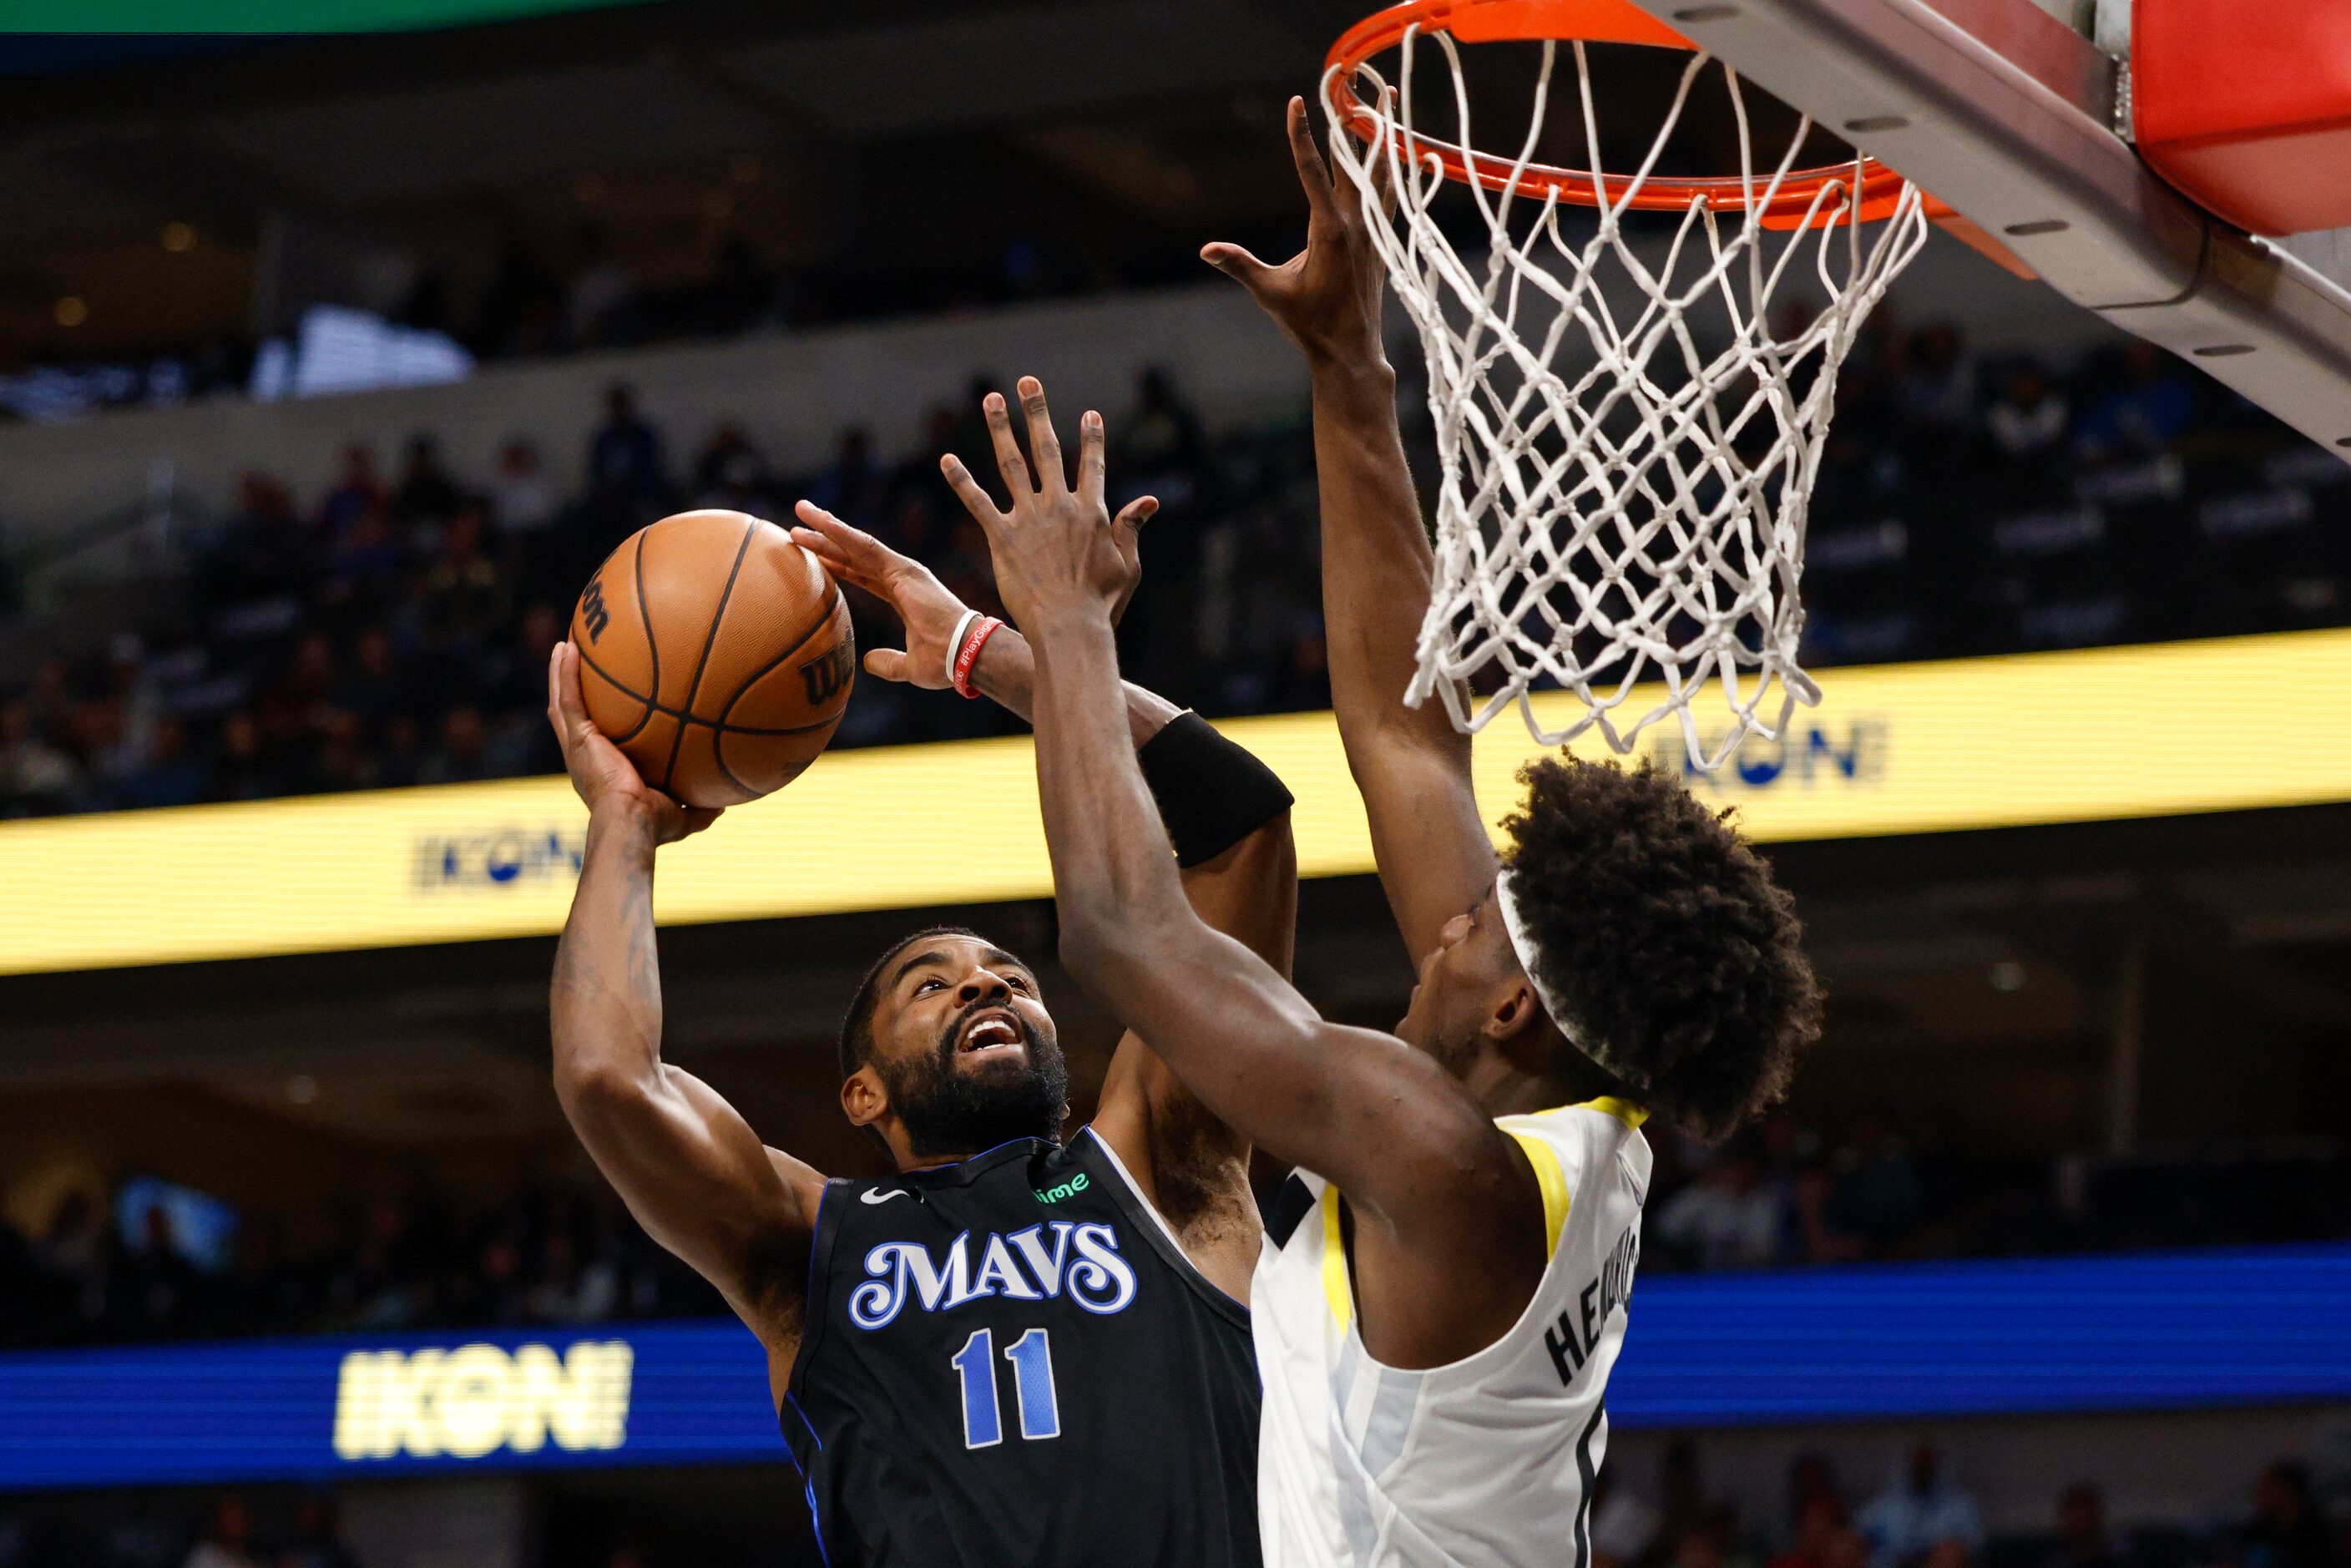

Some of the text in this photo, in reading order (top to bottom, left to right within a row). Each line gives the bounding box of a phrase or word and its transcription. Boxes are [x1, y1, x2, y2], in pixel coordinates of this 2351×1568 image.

[1031, 1173, 1090, 1204] ime
[848, 1222, 1137, 1330] MAVS
[335, 1339, 634, 1459] IKON
[952, 1328, 1061, 1449] 11
